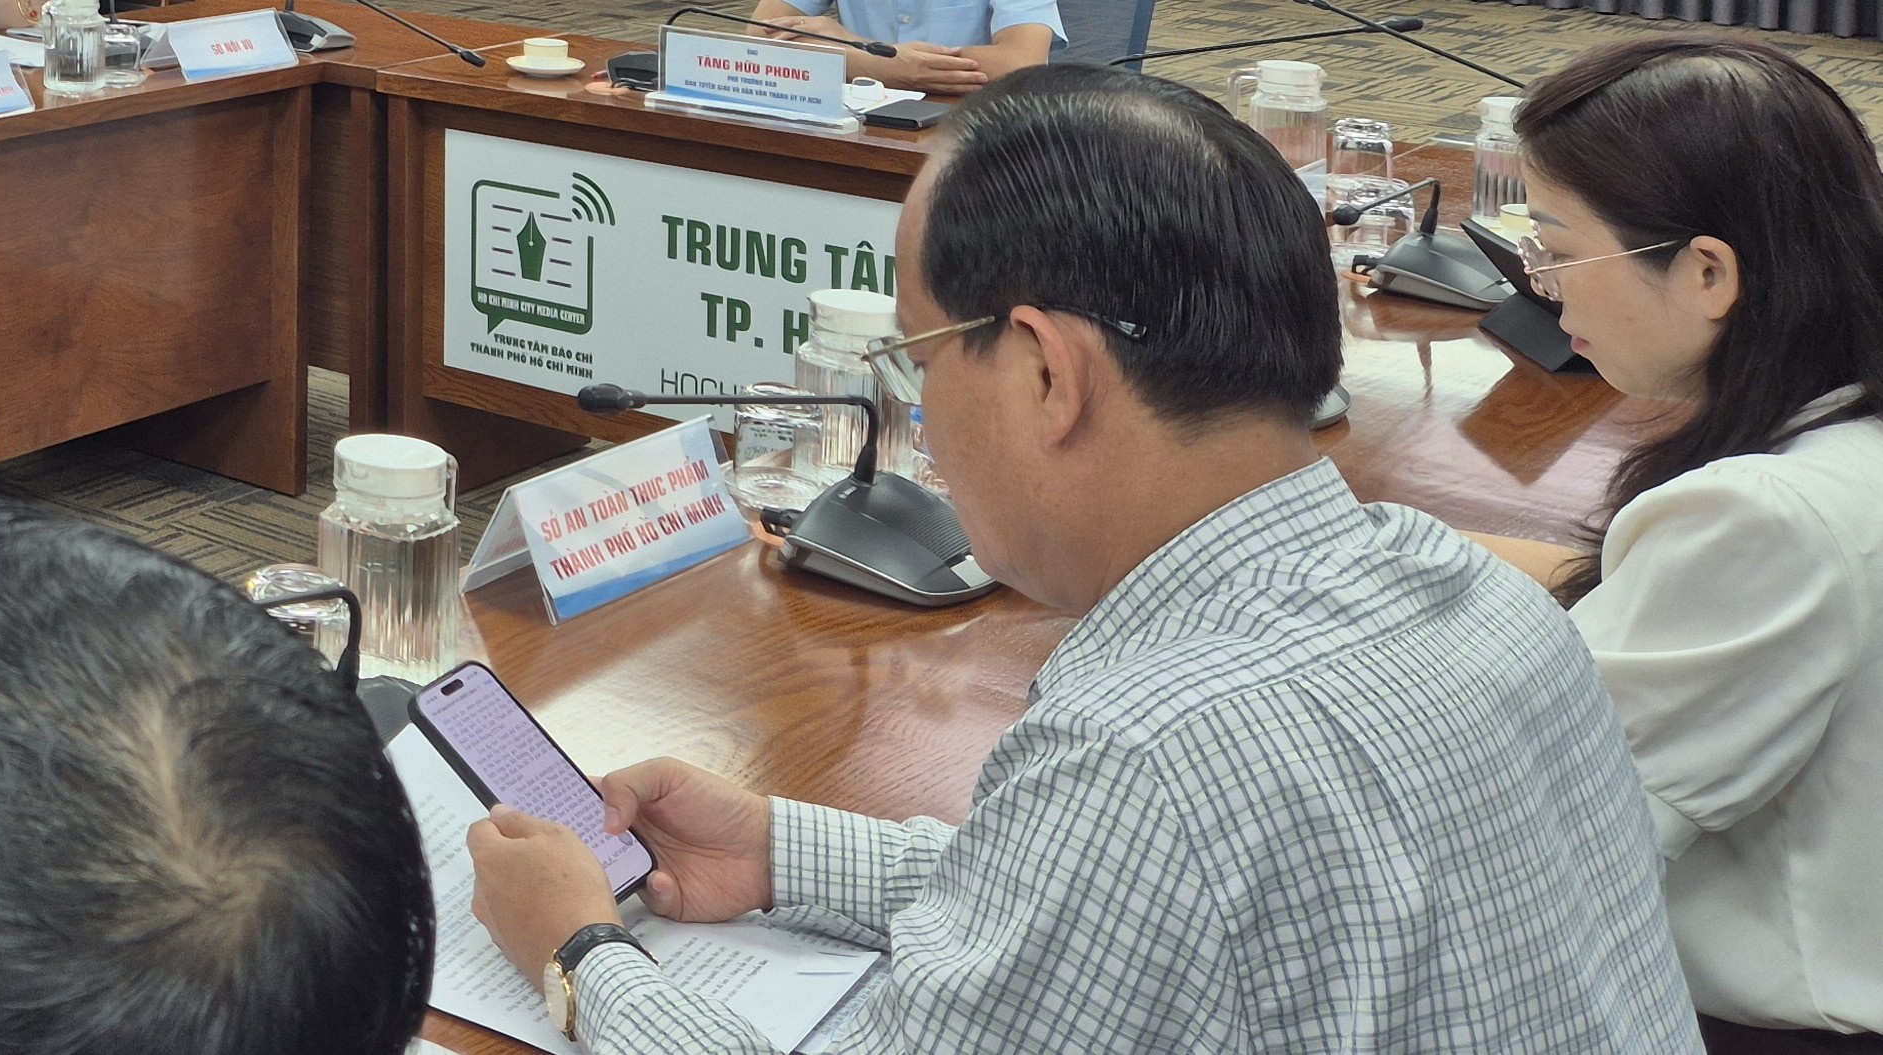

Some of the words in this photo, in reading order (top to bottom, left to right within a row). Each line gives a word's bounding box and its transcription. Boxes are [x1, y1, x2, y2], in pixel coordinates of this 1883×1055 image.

[697, 54, 731, 70] TĂNG
[735, 59, 761, 74] HỮU
[765, 65, 810, 82] PHONG
[661, 214, 807, 284] TRUNG
[520, 301, 536, 314] CITY
[536, 305, 559, 320] MEDIA
[559, 310, 585, 325] CENTER
[701, 291, 764, 349] TP.
[470, 342, 504, 360] THÀNH
[507, 349, 527, 364] PHỐ
[529, 355, 544, 369] HỒ
[546, 359, 564, 373] CHÍ
[566, 365, 593, 380] MINH
[494, 333, 526, 350] TRUNG
[527, 338, 549, 354] TÂM
[551, 345, 572, 360] BÁO
[575, 351, 593, 365] CHÍ
[539, 508, 563, 544] SỞ
[566, 508, 589, 535] AN
[588, 489, 630, 524] TOÀN
[631, 476, 668, 508] THỰC
[666, 454, 711, 494] PHẨM
[549, 542, 605, 581] THÀNH
[606, 520, 638, 560] PHỐ
[637, 515, 661, 546] HỒ
[657, 503, 687, 537] CHÍ
[684, 493, 726, 526] MINH
